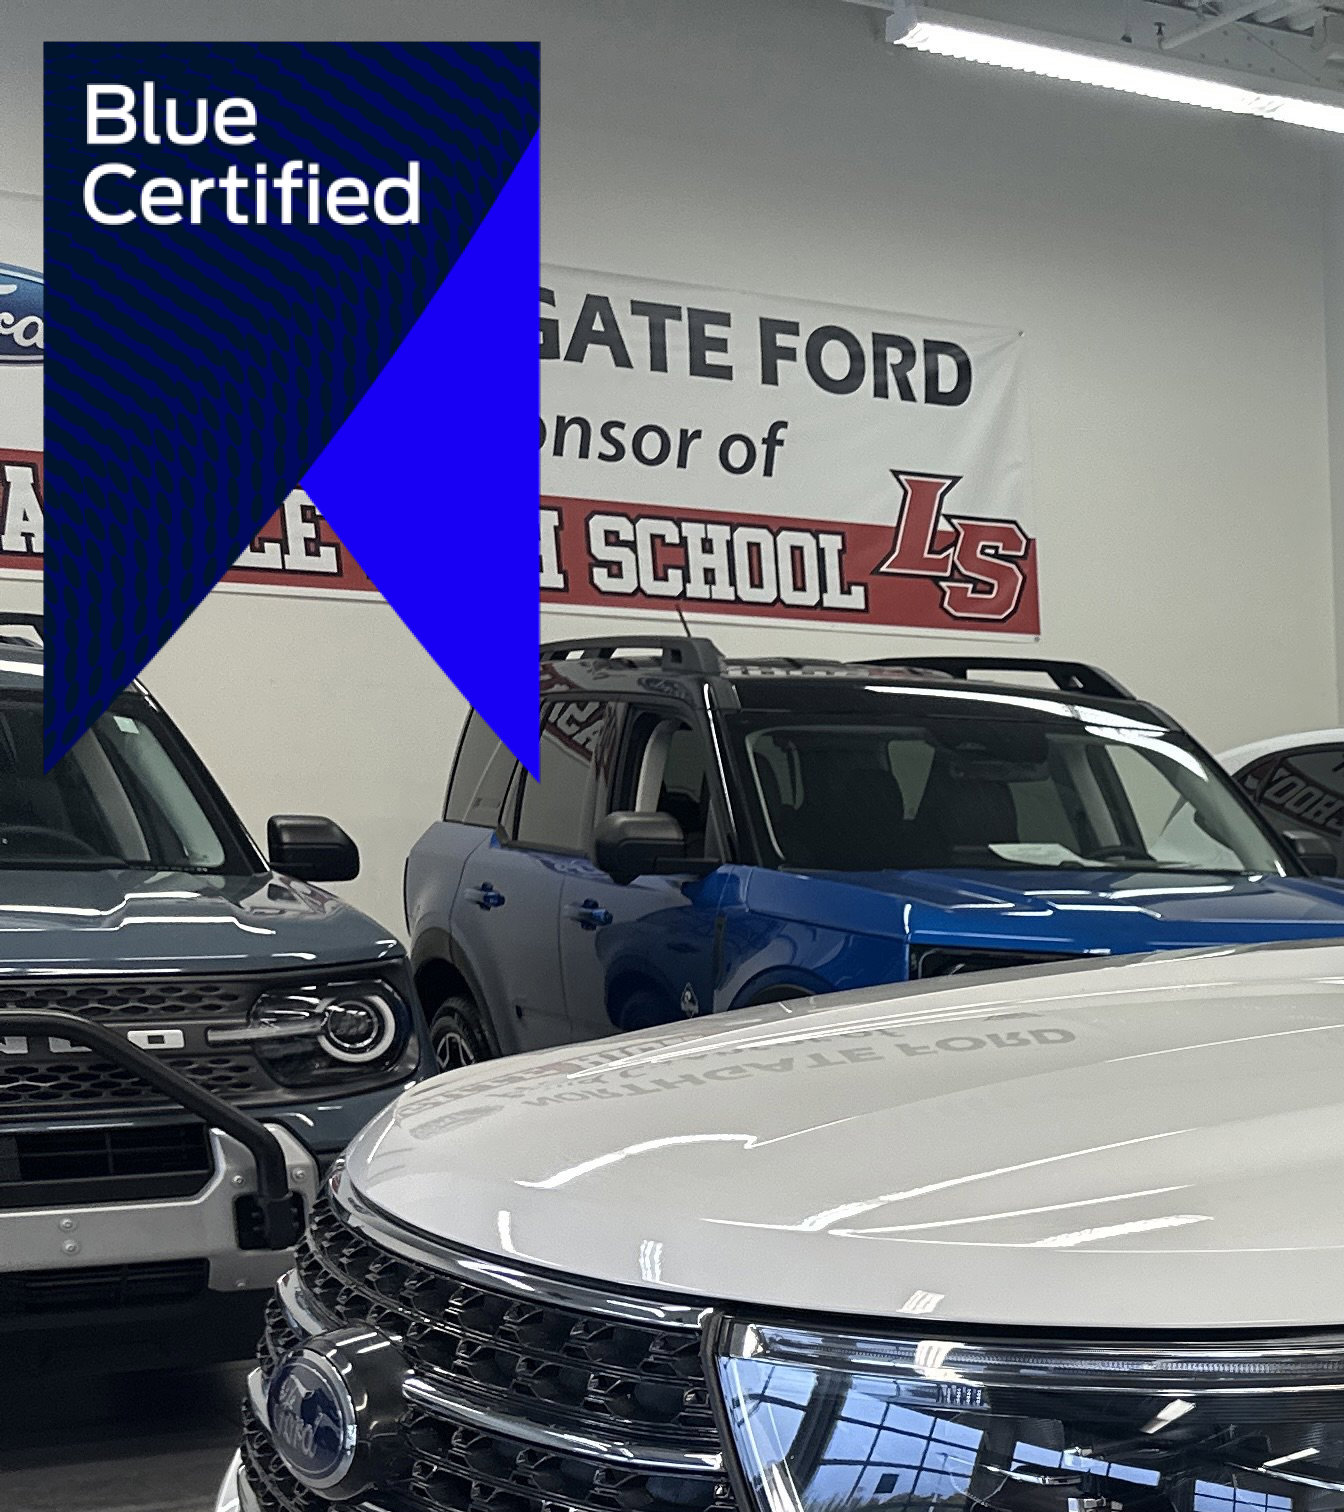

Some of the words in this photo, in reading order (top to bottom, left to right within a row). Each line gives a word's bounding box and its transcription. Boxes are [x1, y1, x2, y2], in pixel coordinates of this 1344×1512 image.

[759, 316, 973, 407] FORD
[539, 415, 702, 469] nsor
[718, 420, 788, 477] of
[587, 514, 867, 612] SCHOOL
[871, 470, 1031, 623] LS
